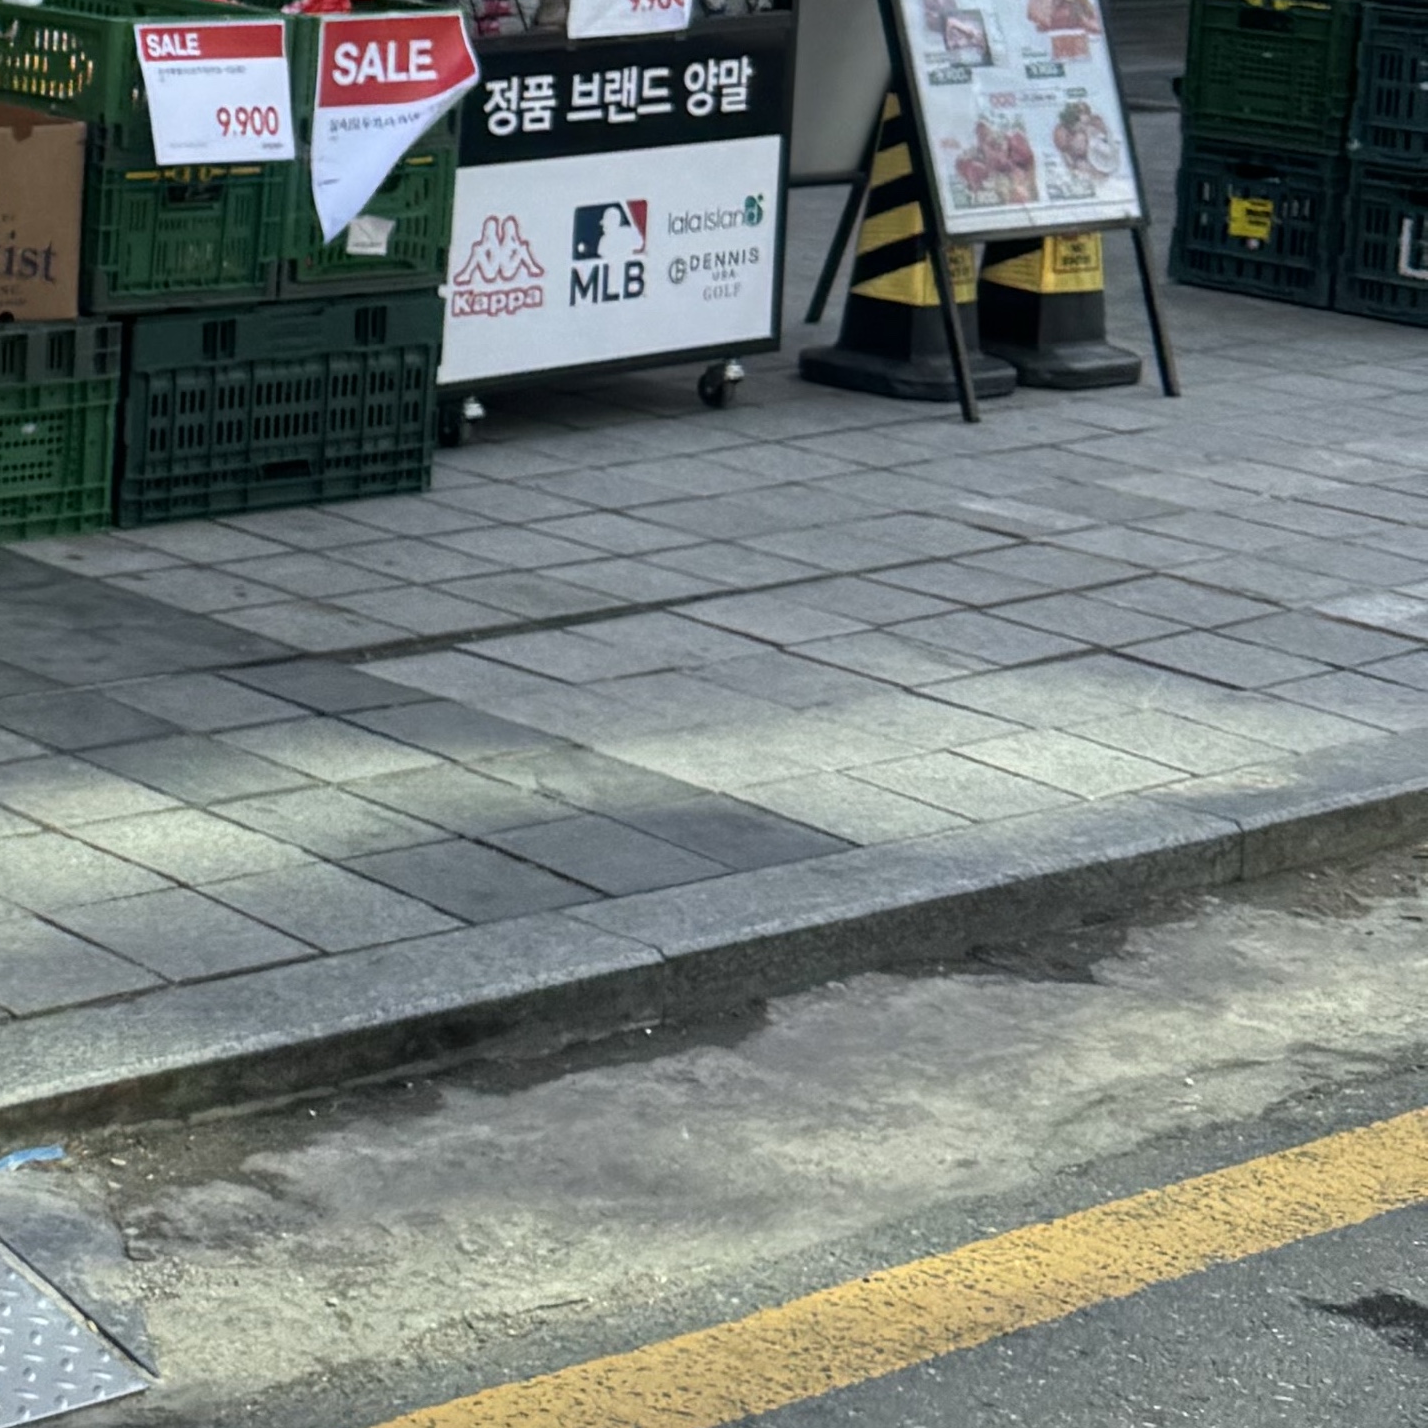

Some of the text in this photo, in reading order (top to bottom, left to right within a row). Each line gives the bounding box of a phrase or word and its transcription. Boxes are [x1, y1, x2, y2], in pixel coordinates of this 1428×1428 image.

[145, 32, 201, 58] SALE
[331, 38, 438, 86] SALE
[483, 55, 754, 137] 정품 브랜드 양말
[688, 247, 761, 273] DENNIS
[569, 260, 647, 307] MLB
[702, 282, 743, 302] GOLF
[451, 285, 544, 317] Kappa
